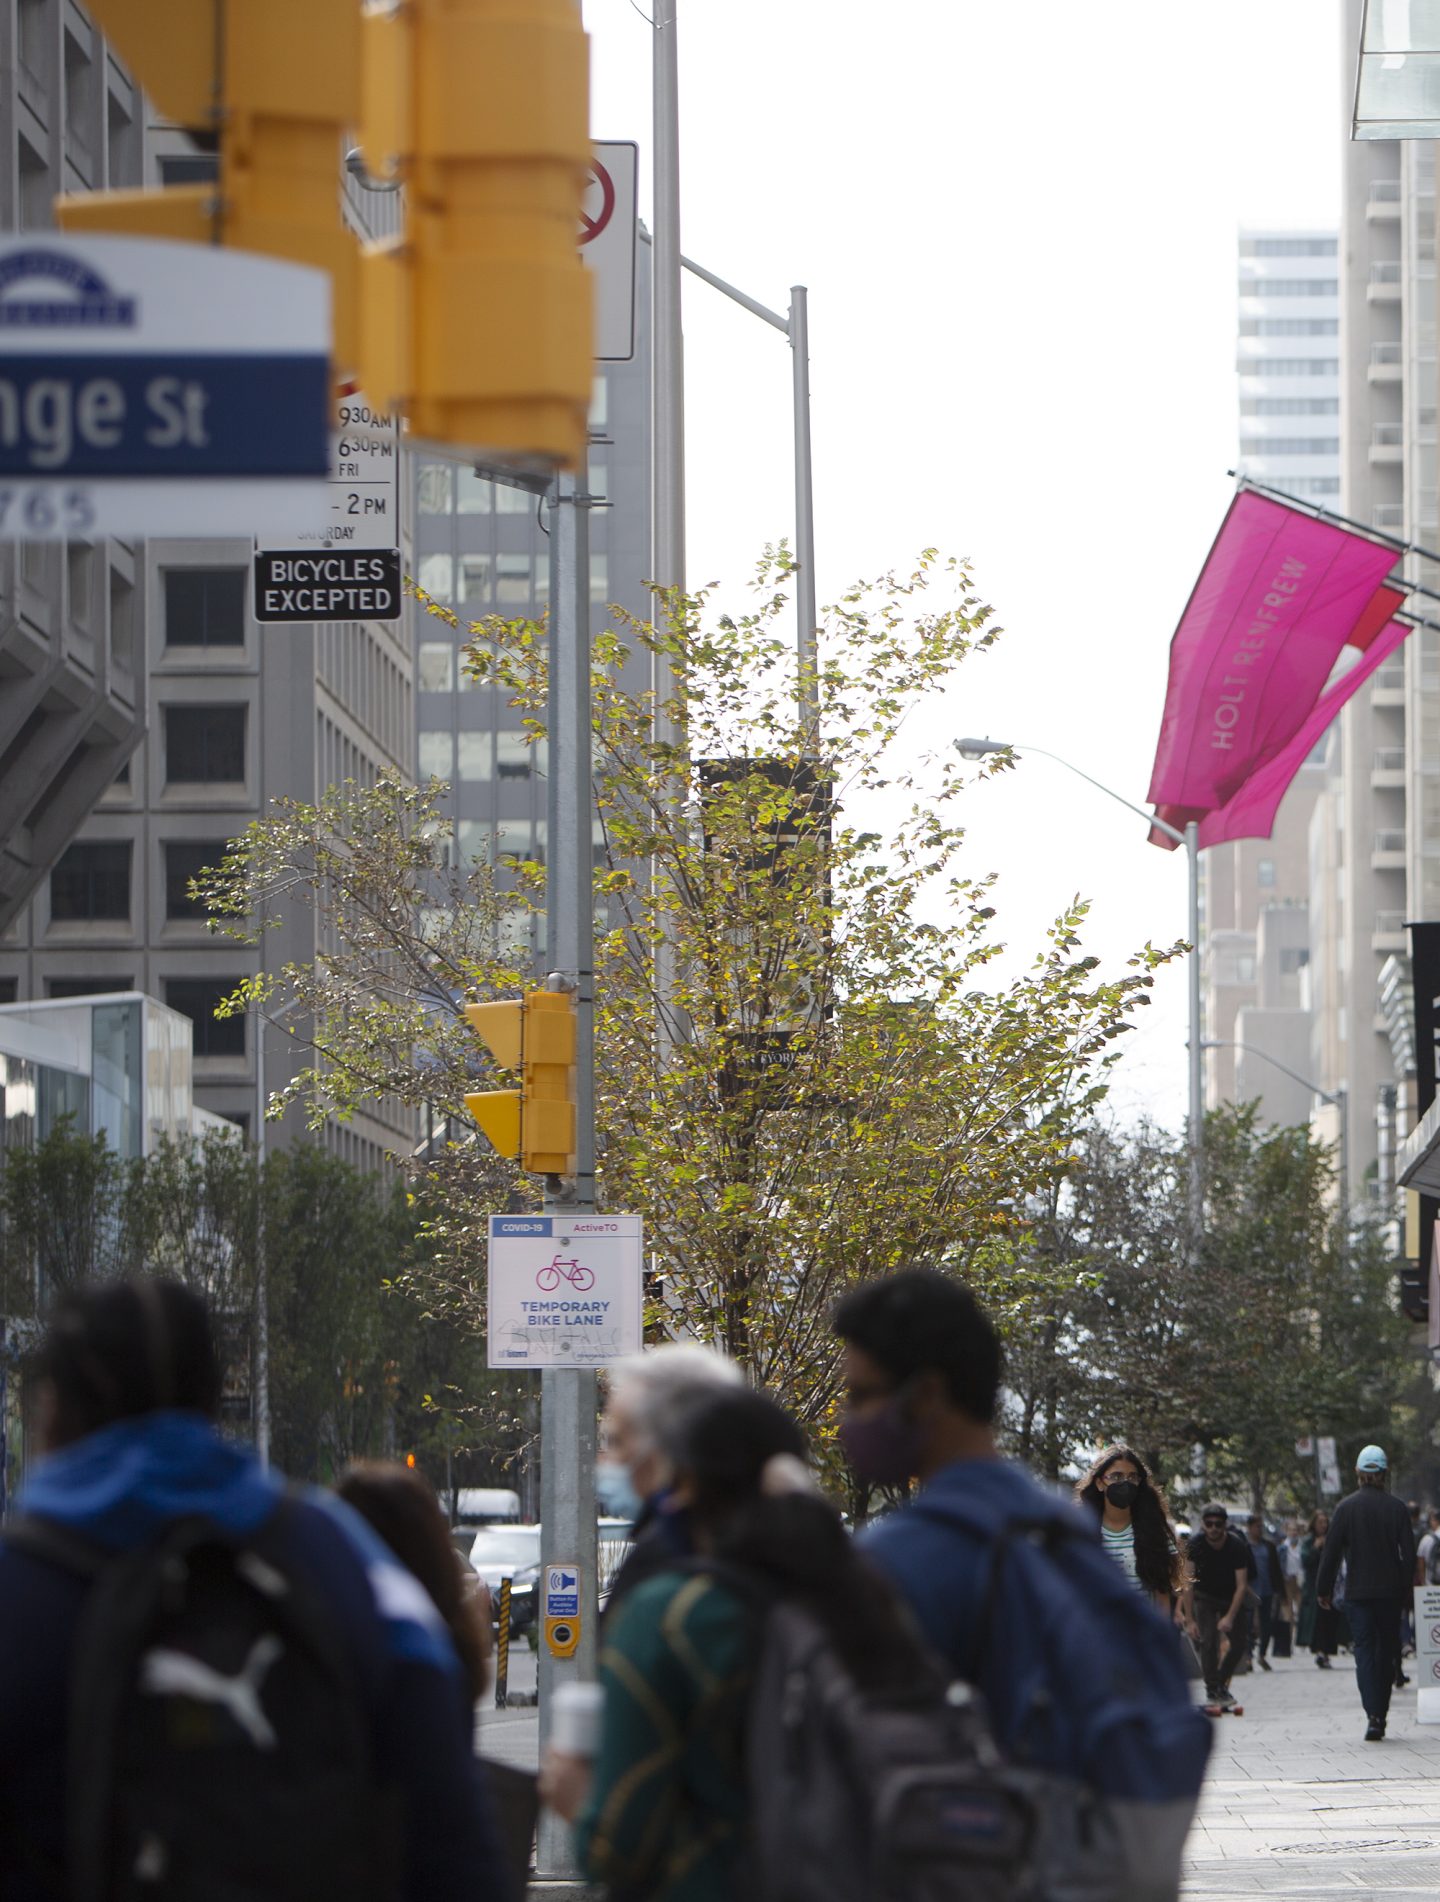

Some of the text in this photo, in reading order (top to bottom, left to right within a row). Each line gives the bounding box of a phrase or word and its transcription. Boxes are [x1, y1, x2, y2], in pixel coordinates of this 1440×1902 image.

[145, 376, 210, 447] St
[338, 464, 359, 477] FRI
[297, 526, 356, 540] URDAY
[271, 559, 384, 582] BICYCLES
[264, 588, 391, 612] EXCEPTED
[1210, 556, 1308, 750] HOLT RENFREW
[502, 1223, 618, 1232] COVID-19 ActiveTO
[520, 1301, 610, 1312] TEMPORARY
[528, 1315, 603, 1326] BIKE LANE
